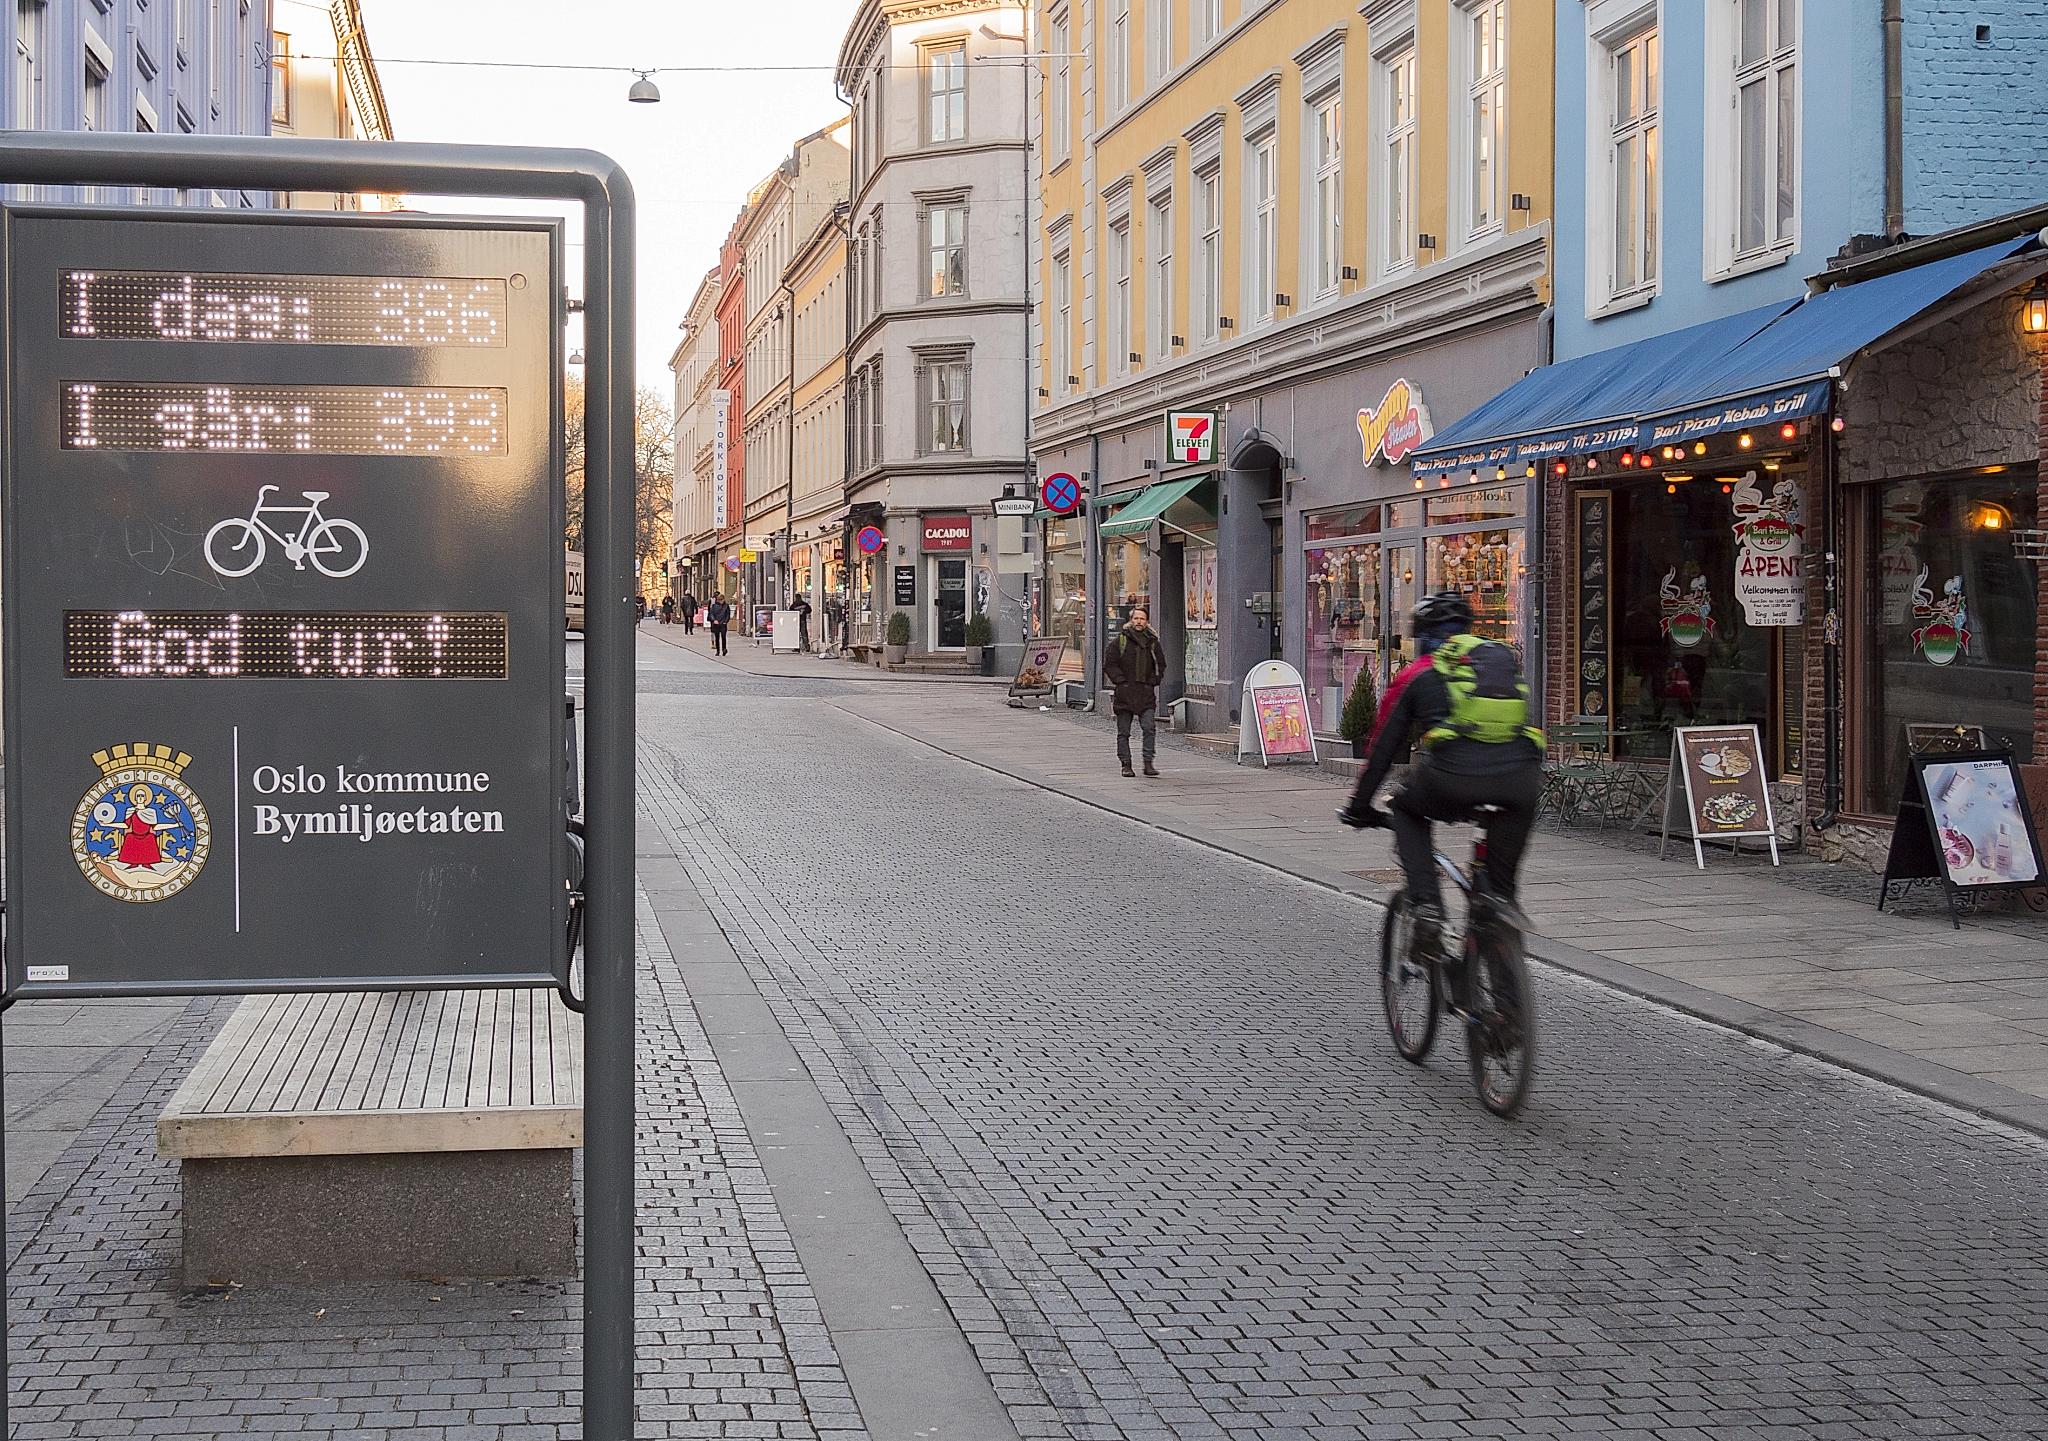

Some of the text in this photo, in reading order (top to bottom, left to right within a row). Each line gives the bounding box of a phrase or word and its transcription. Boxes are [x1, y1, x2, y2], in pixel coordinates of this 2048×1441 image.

[71, 272, 498, 344] I dag: 386
[72, 384, 97, 447] I
[375, 391, 498, 452] 393
[1358, 383, 1409, 462] Yummy
[1653, 392, 1808, 440] Bari Pizza Kebab Grill
[1413, 459, 1433, 472] Bari
[1433, 456, 1458, 468] Pizza
[1458, 451, 1486, 466] Kebab
[1488, 446, 1510, 461] Grill
[998, 503, 1032, 511] MINIBANK
[925, 528, 970, 539] CACADOU
[1752, 525, 1789, 536] Bari Pizza
[1767, 536, 1782, 545] Grill
[1741, 584, 1789, 595] Velkommen
[1755, 610, 1768, 618] Ring
[112, 610, 241, 676] God
[252, 764, 490, 794] Oslo kommune
[252, 803, 505, 844] Bymiljøetaten
[113, 886, 165, 901] OSLO
